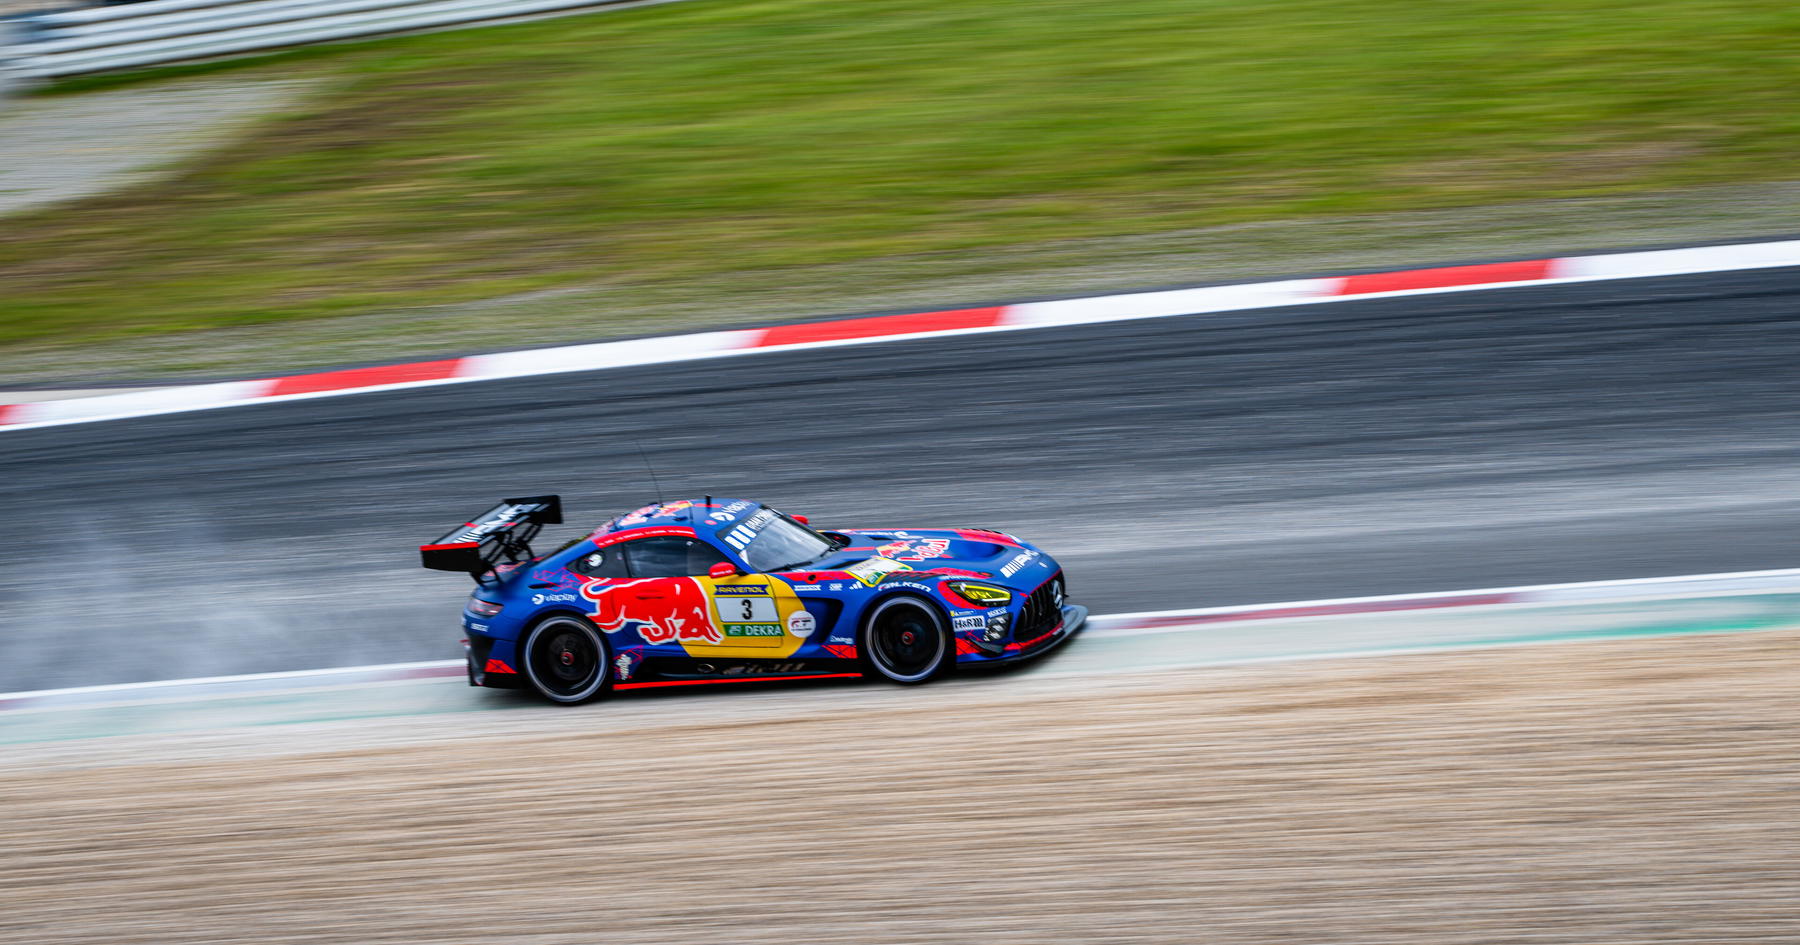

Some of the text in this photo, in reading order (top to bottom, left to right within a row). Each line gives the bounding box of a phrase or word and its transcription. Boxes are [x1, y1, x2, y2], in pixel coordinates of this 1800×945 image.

[718, 585, 765, 594] RAVENOL
[878, 581, 932, 593] FALKEN
[741, 599, 753, 620] 3
[744, 625, 784, 636] DEKRA
